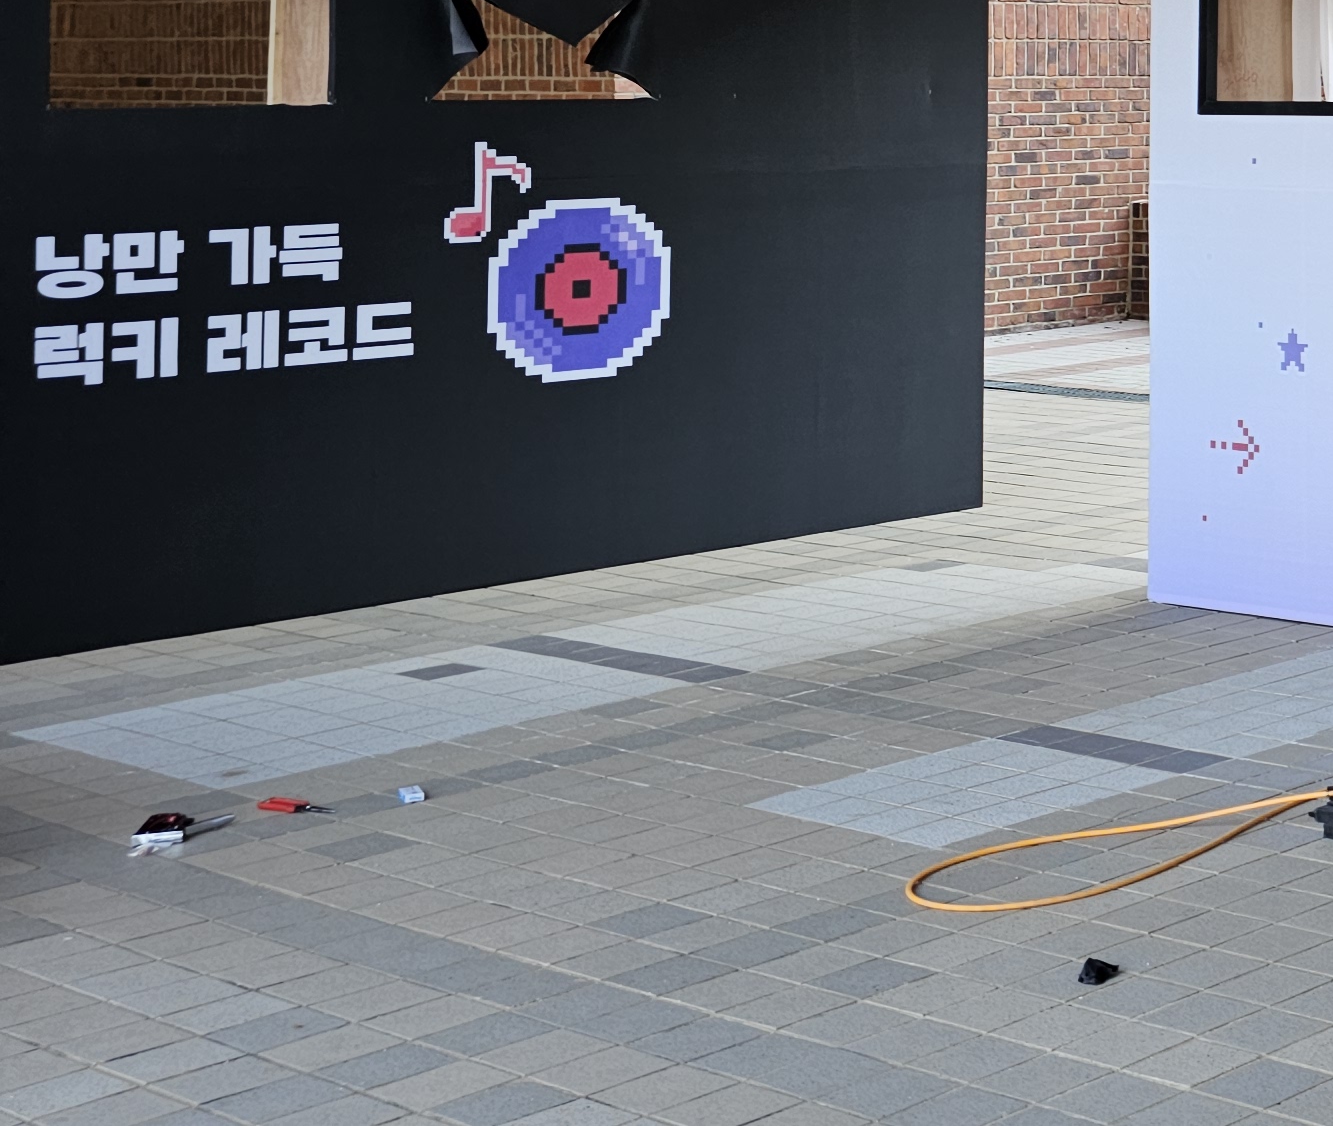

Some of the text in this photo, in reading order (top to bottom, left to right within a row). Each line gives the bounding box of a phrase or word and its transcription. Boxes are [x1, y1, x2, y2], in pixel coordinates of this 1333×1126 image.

[35, 222, 344, 300] 낭만 가득
[34, 301, 415, 386] 럭키 레코드
